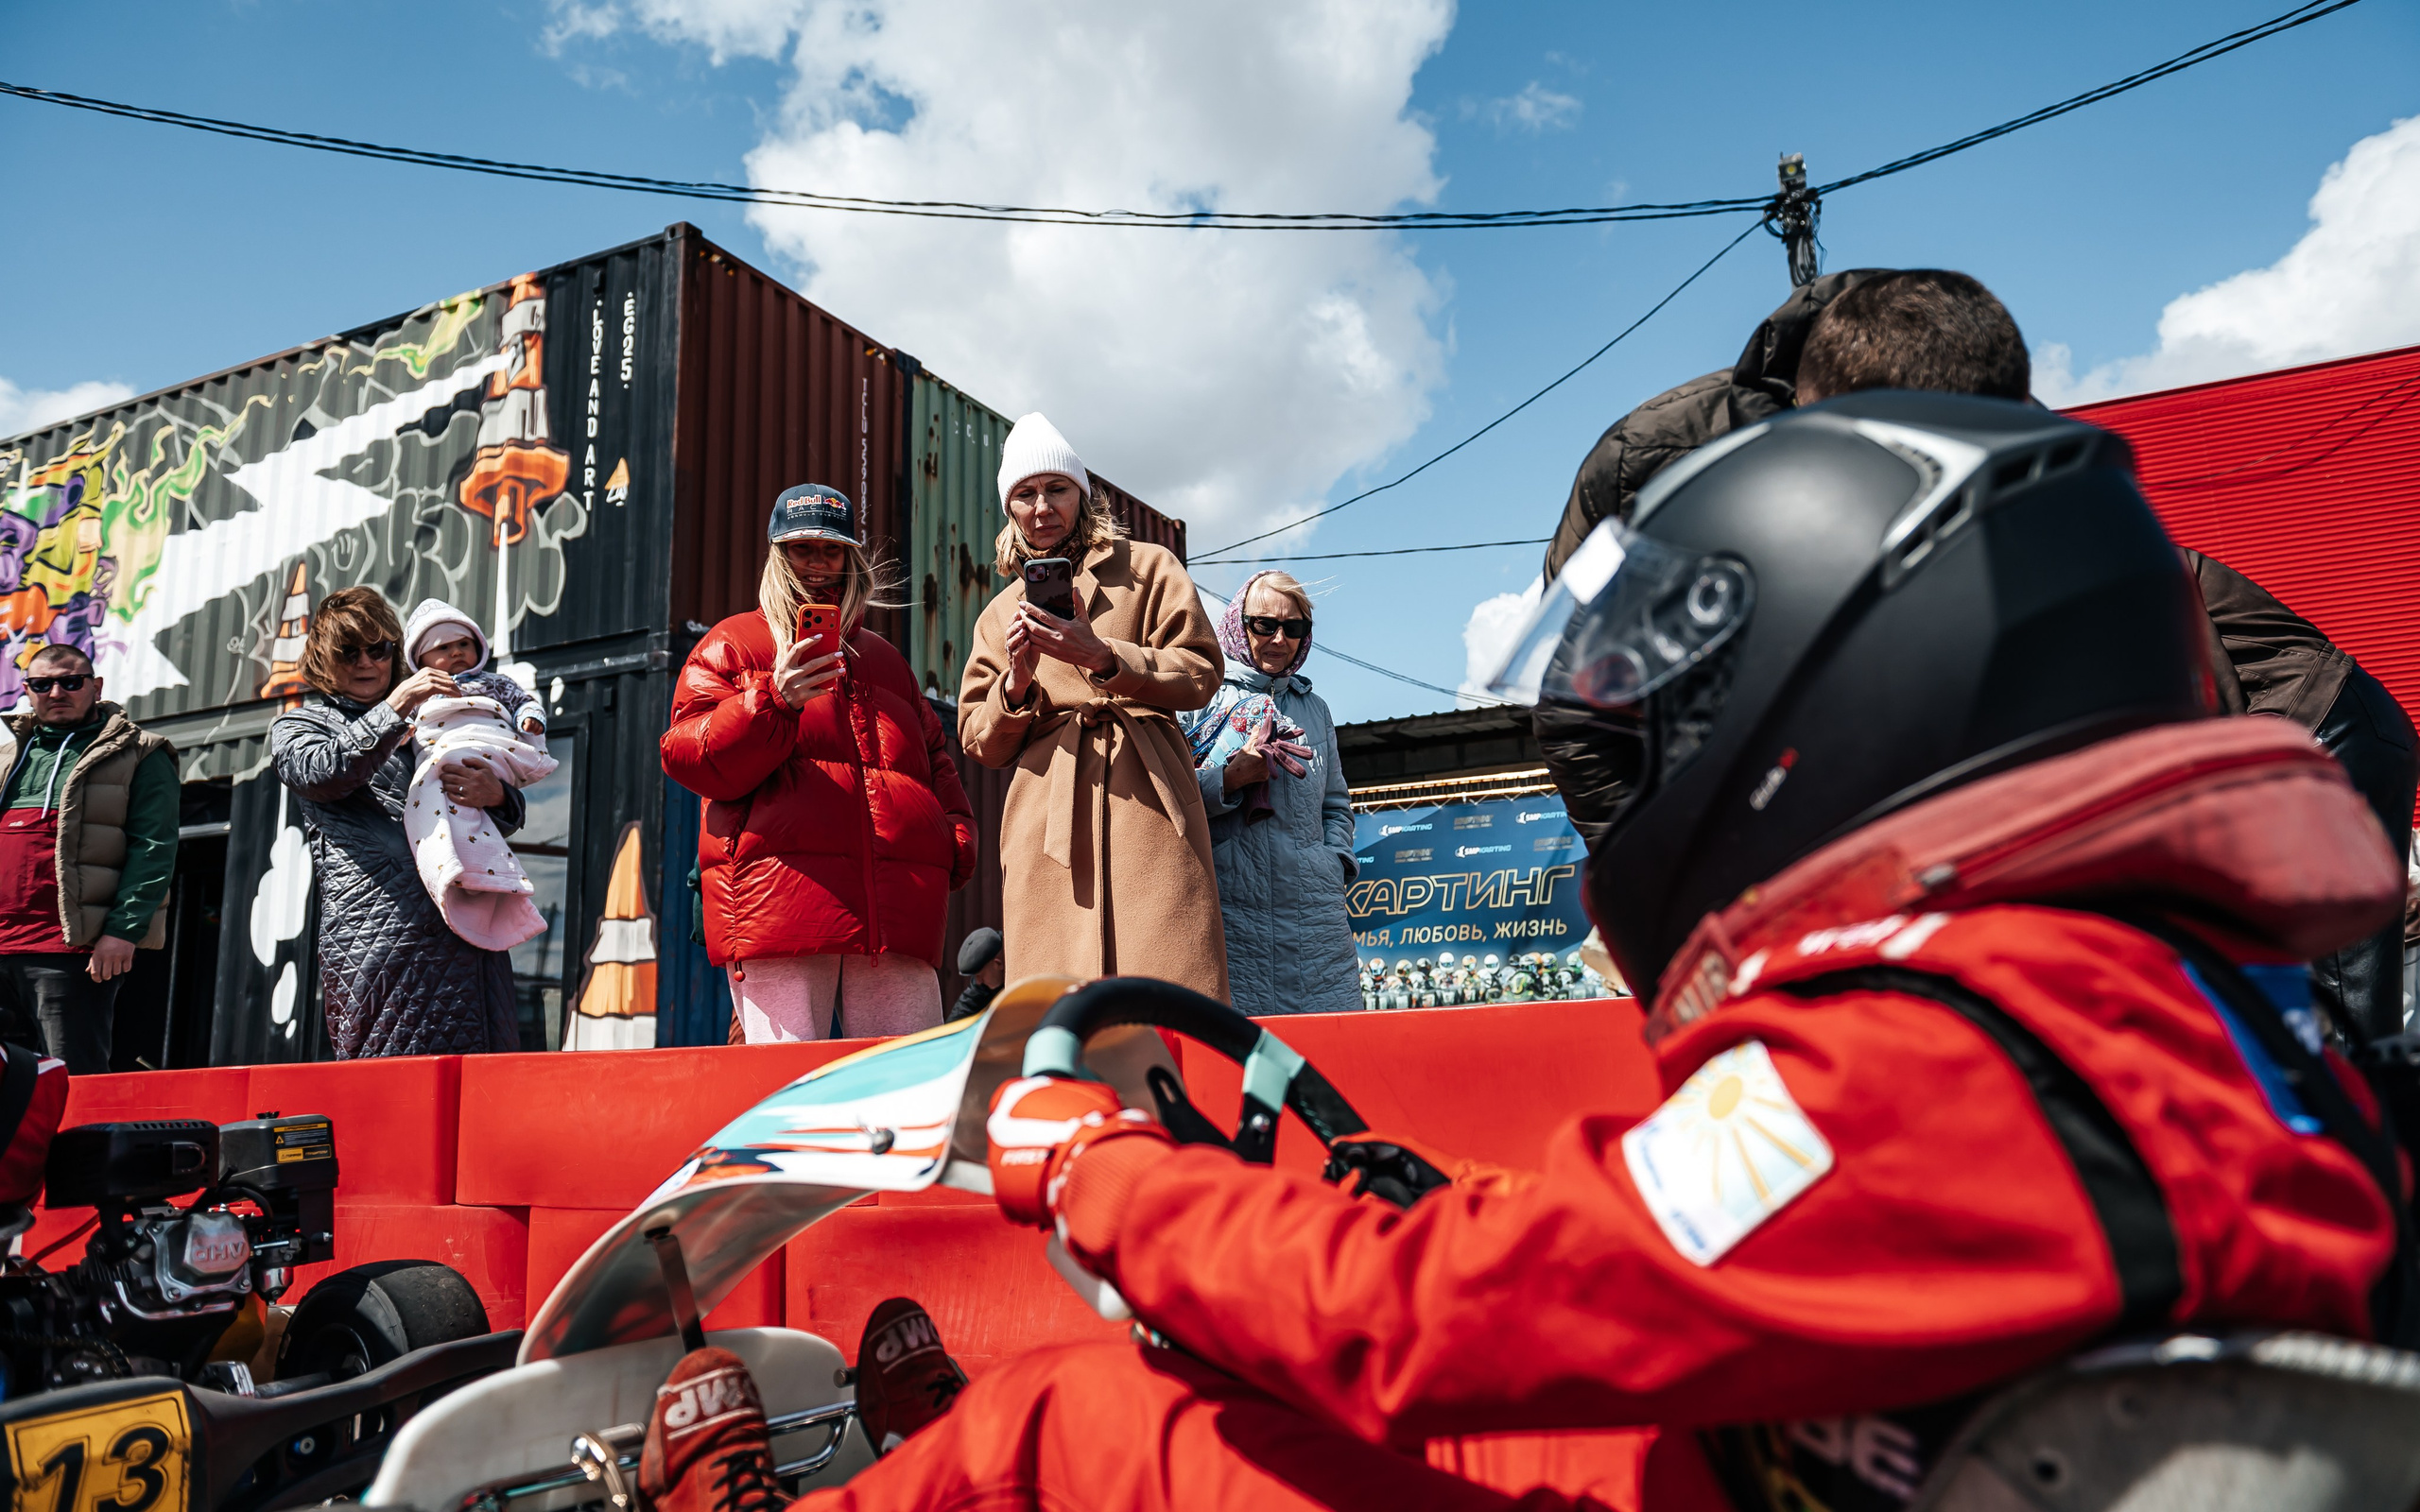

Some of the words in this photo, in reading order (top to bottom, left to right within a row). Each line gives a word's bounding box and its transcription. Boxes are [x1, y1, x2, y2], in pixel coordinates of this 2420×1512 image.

[587, 378, 600, 438] AND
[583, 443, 596, 511] ART
[786, 495, 804, 508] Red
[804, 494, 821, 506] Bull
[786, 505, 847, 516] RACING
[1344, 865, 1575, 918] КАРТИНГ
[1353, 929, 1394, 949] МЬЯ,
[1399, 923, 1487, 945] ЛЮБОВЬ,
[1493, 918, 1568, 939] ЖИЗНЬ
[39, 1423, 173, 1512] 13
